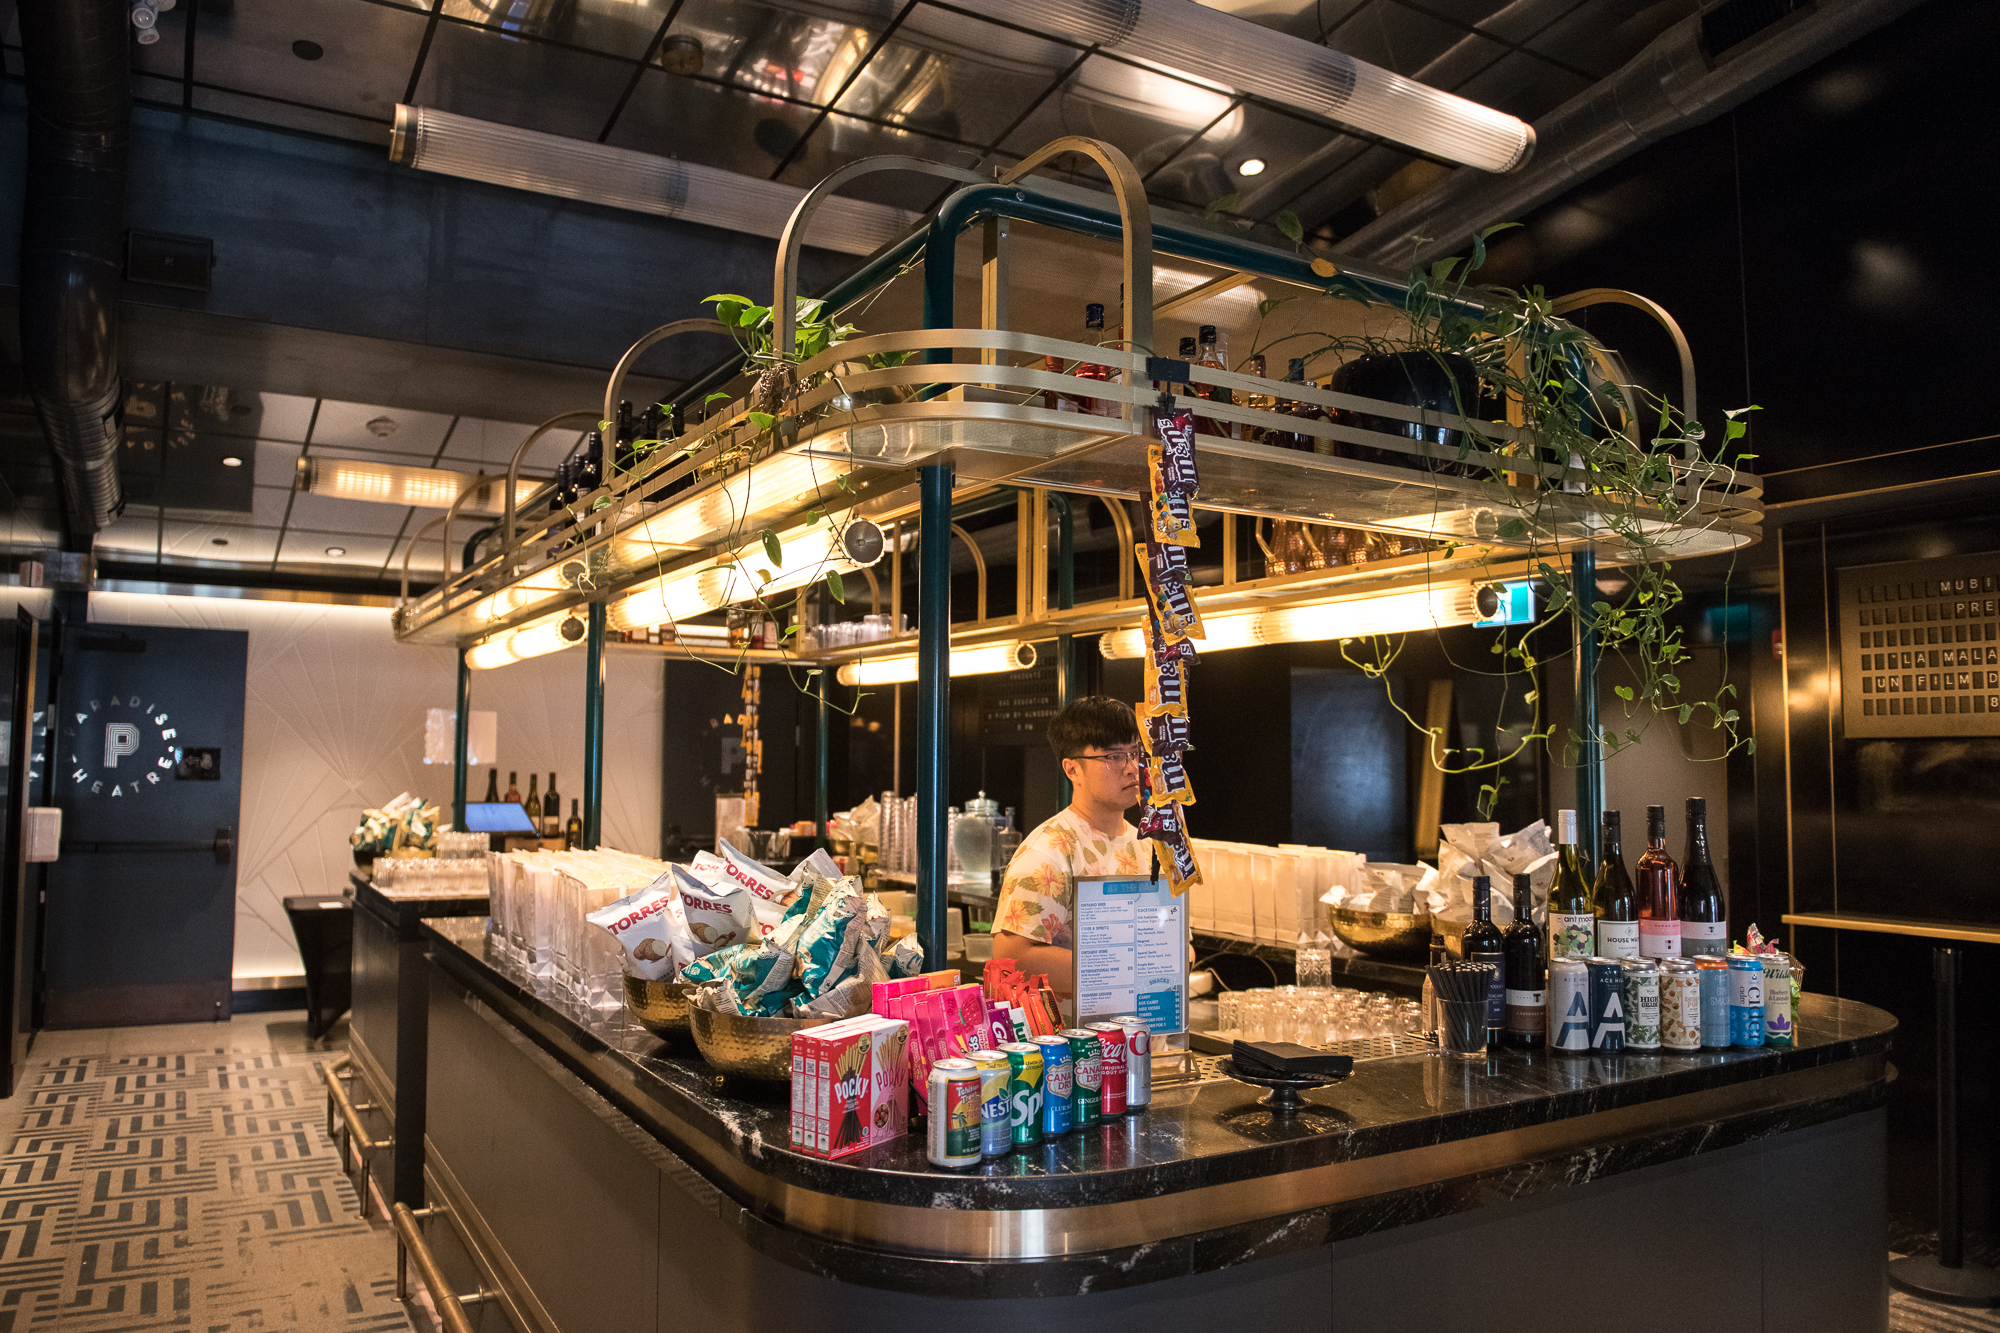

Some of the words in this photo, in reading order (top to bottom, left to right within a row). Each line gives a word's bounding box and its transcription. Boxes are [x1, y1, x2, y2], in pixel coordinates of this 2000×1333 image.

[1940, 577, 1991, 592] MUBI
[1944, 649, 1997, 662] MALA
[1878, 677, 1899, 688] UN
[1918, 674, 1970, 686] FILM
[104, 722, 140, 768] P
[724, 860, 775, 900] TORRES
[608, 896, 669, 935] TORRES
